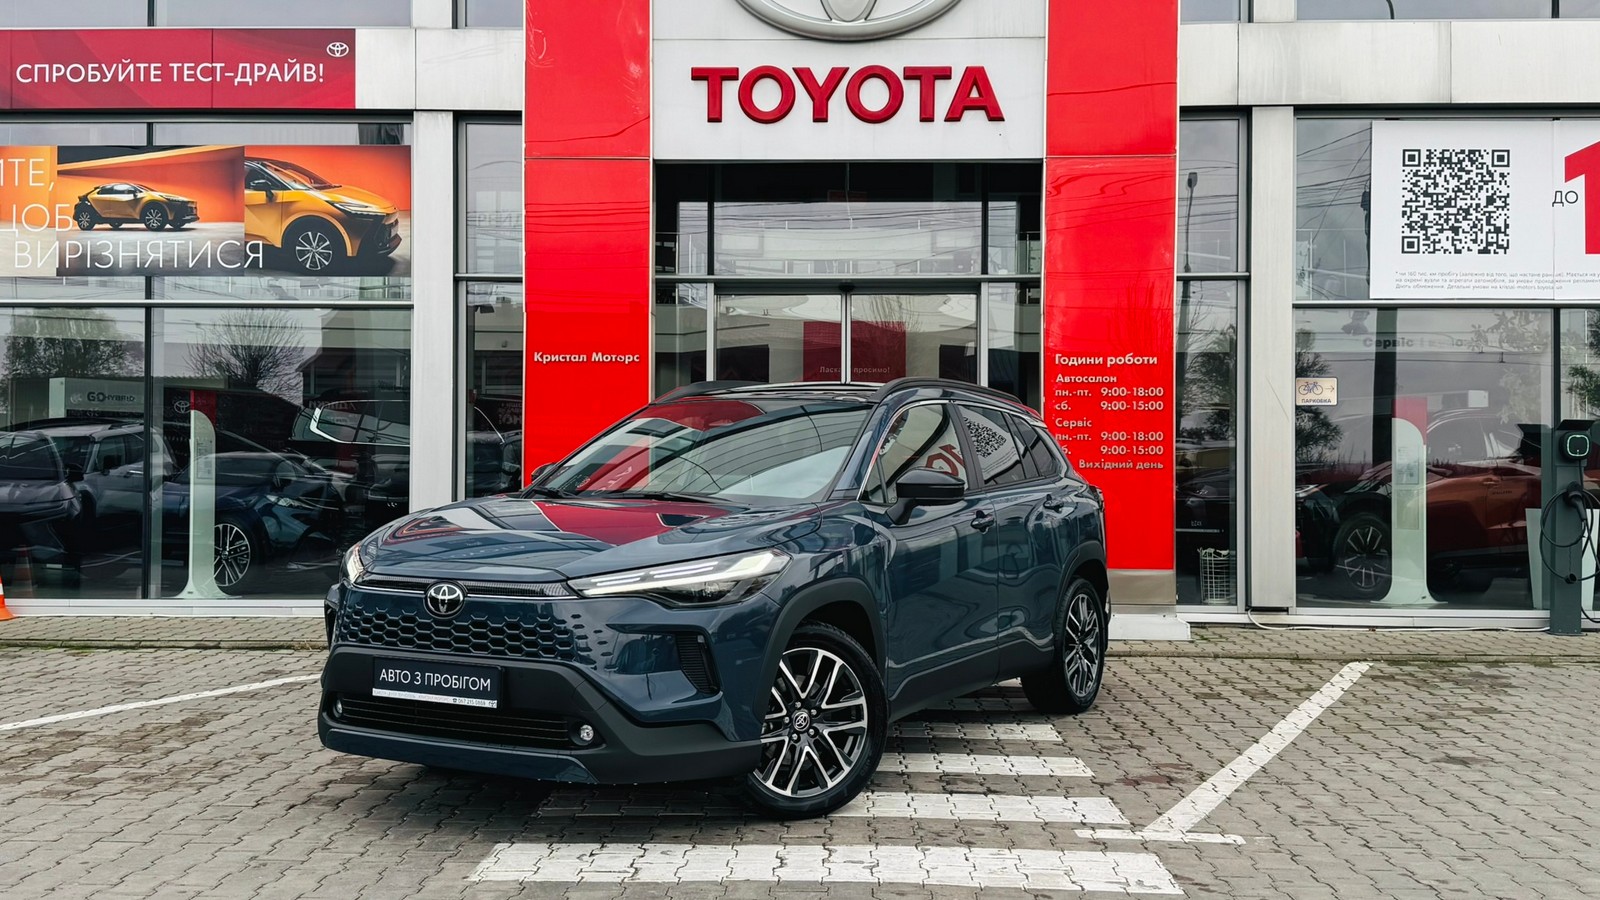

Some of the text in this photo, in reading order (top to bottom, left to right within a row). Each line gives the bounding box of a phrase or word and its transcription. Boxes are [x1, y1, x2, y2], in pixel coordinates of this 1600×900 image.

[16, 59, 324, 85] СПРОБУЙТЕ ТЕСТ-ДРАЙВ!
[690, 65, 1005, 124] TOYOTA
[0, 158, 54, 192] ТЕ,
[14, 240, 263, 269] ВИРІЗНЯТИСЯ
[533, 352, 640, 364] Кристал Моторс
[1055, 352, 1158, 368] Години роботи
[1056, 373, 1117, 384] Автосалон
[1055, 388, 1092, 397] пн.-пт.
[1055, 400, 1072, 411] сб.
[1055, 417, 1092, 429] Сервіс
[1078, 459, 1164, 470] Вихідний день
[379, 668, 491, 692] АВТО З ПРОБІГОМ
